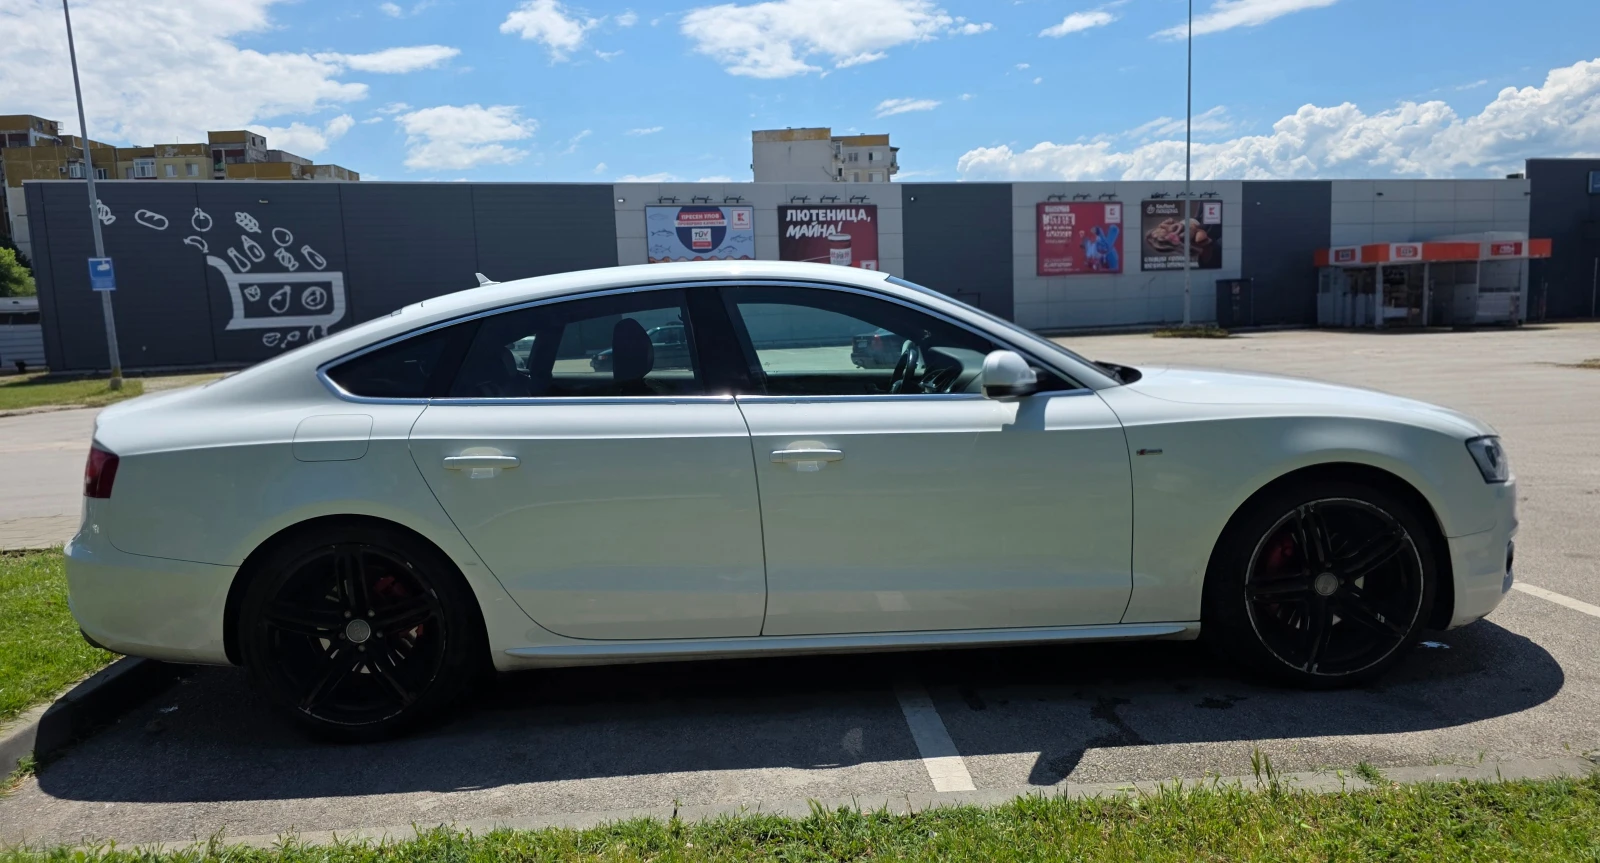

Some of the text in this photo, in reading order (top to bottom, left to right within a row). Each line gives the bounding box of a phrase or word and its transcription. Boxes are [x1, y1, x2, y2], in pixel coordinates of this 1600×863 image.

[786, 208, 871, 222] ЛЮТЕНИЦА,
[694, 230, 709, 238] TÜV
[786, 221, 843, 240] МАЙНА!
